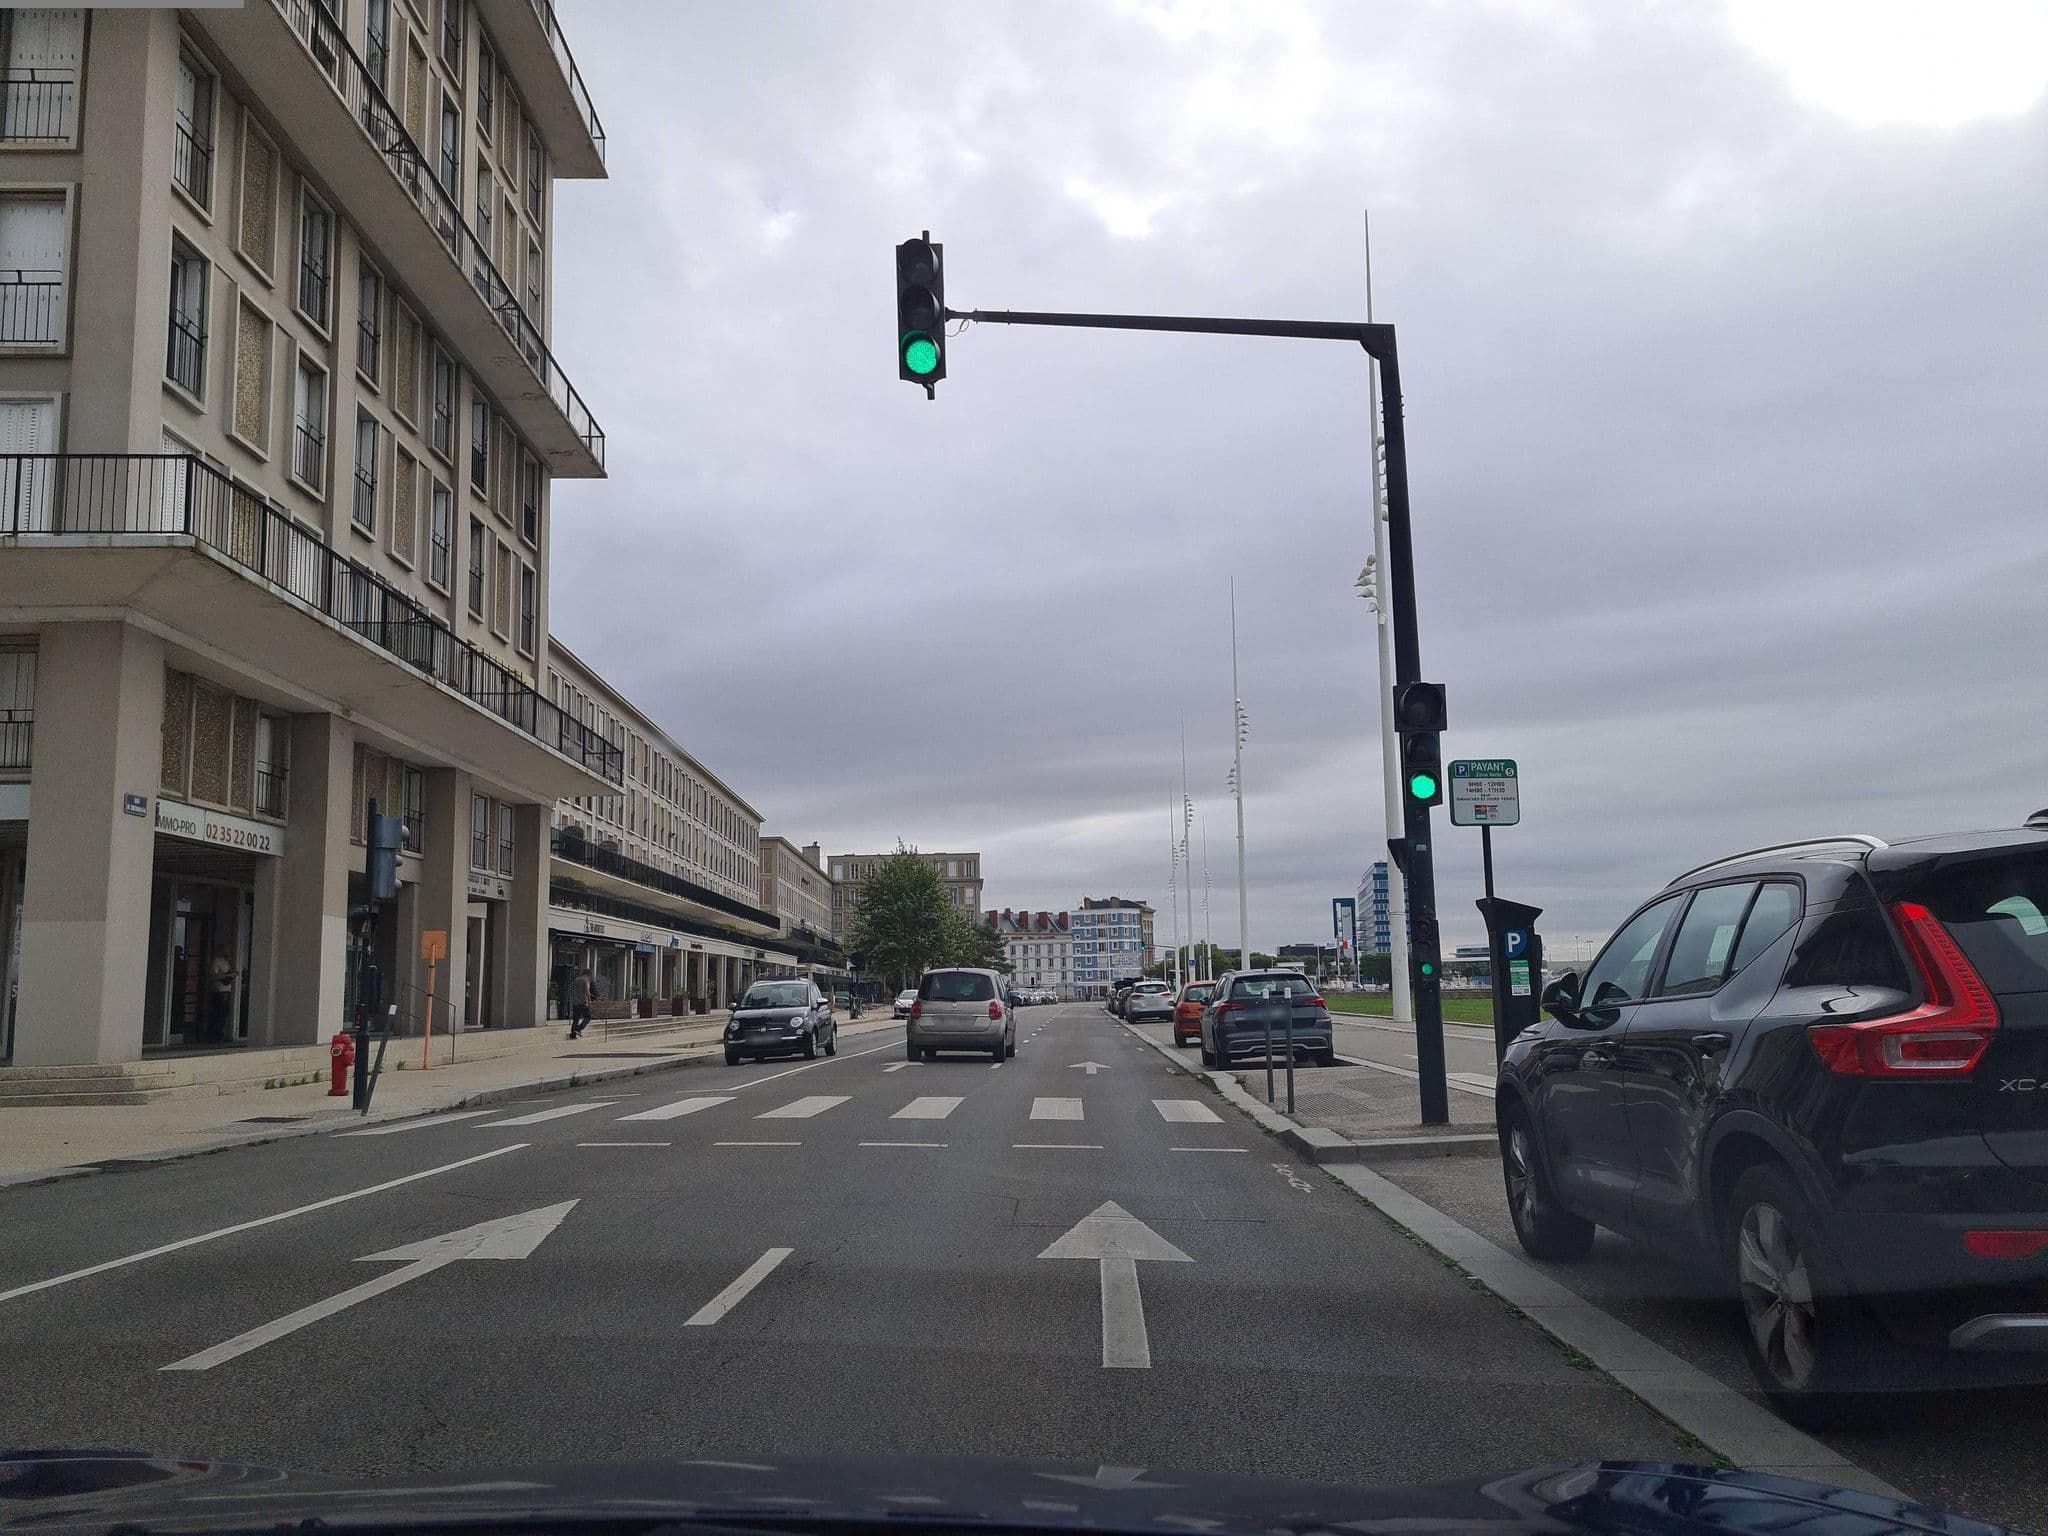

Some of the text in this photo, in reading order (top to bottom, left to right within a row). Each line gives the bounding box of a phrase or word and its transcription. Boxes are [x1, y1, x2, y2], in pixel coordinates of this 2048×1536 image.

[1471, 762, 1505, 771] PAYANT
[206, 823, 270, 851] 02 35 22 00 22
[1507, 932, 1521, 953] P
